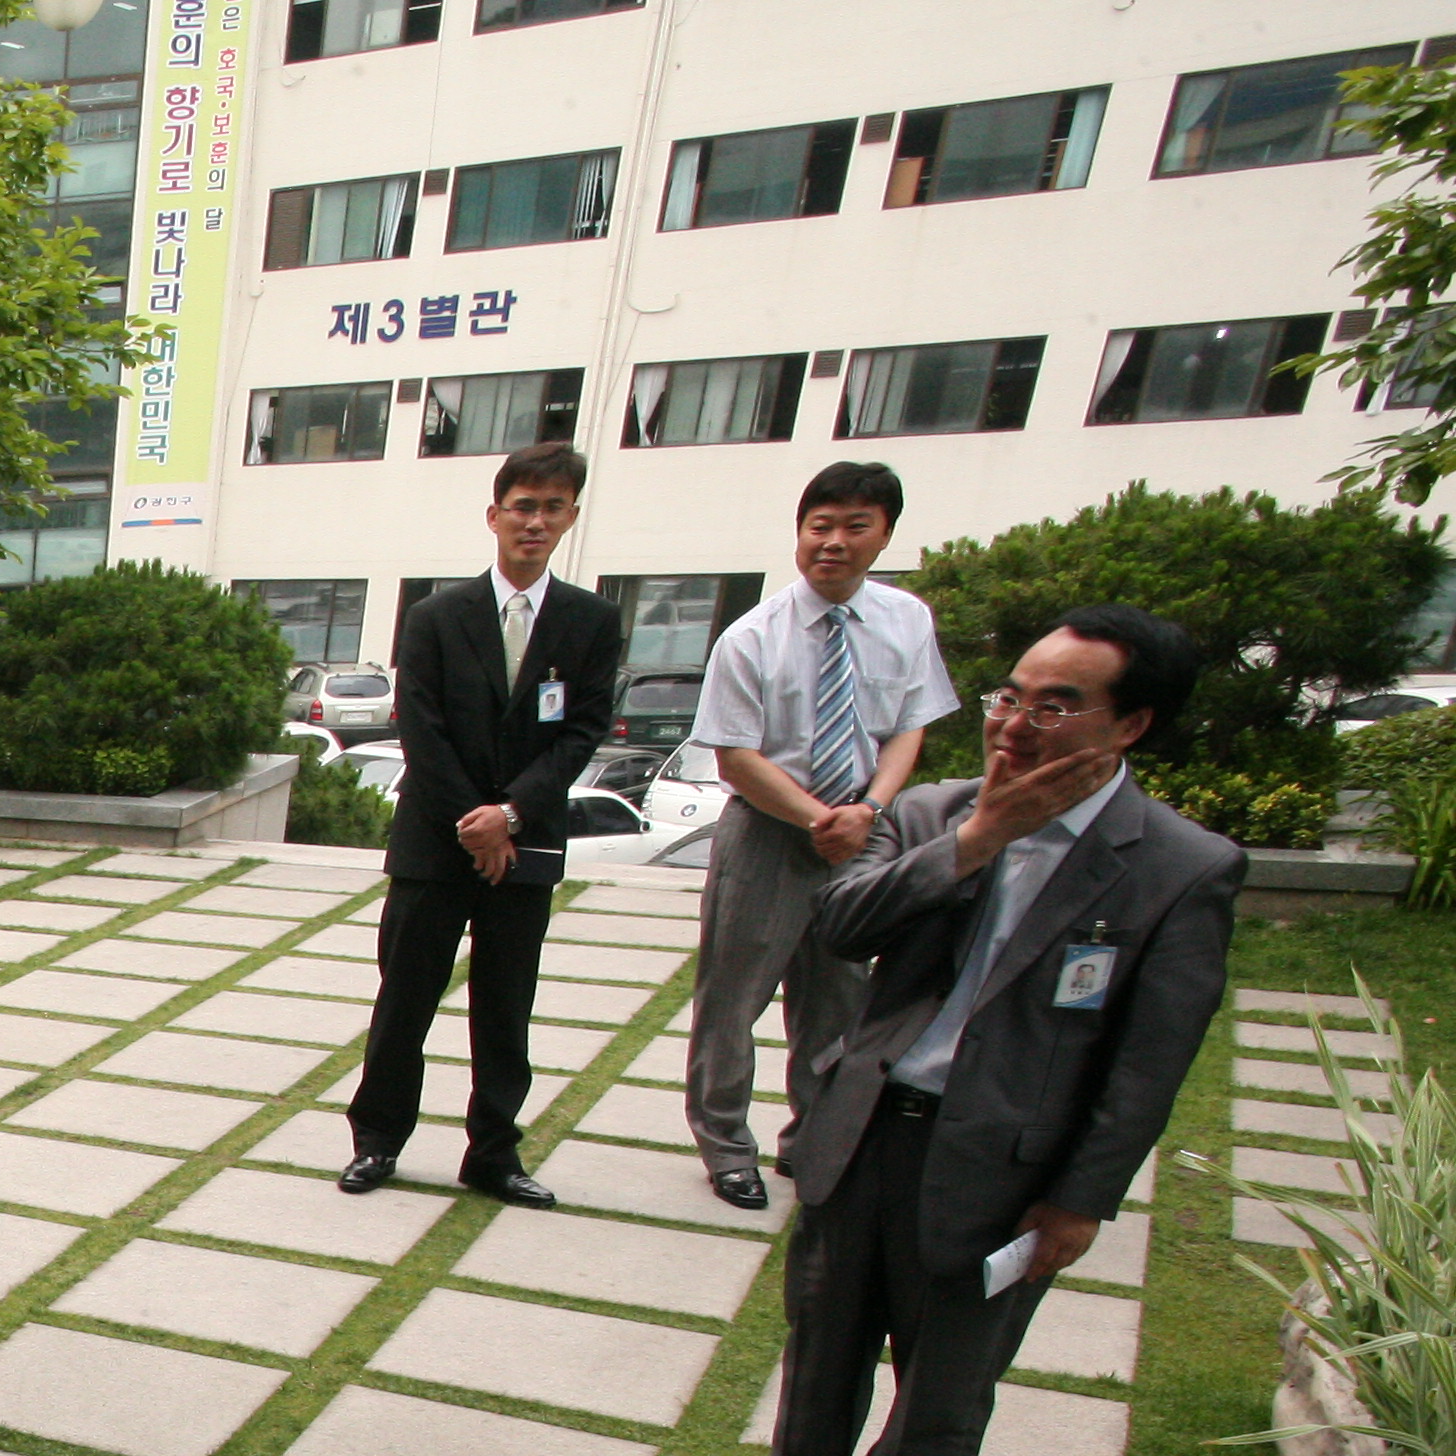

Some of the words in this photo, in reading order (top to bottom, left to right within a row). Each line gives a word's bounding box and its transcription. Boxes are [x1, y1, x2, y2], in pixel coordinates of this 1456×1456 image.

[158, 86, 200, 192] 향기로
[149, 211, 187, 314] 빛나라
[205, 207, 224, 231] 달
[327, 289, 518, 345] 제3별관
[137, 329, 178, 464] 대한민국
